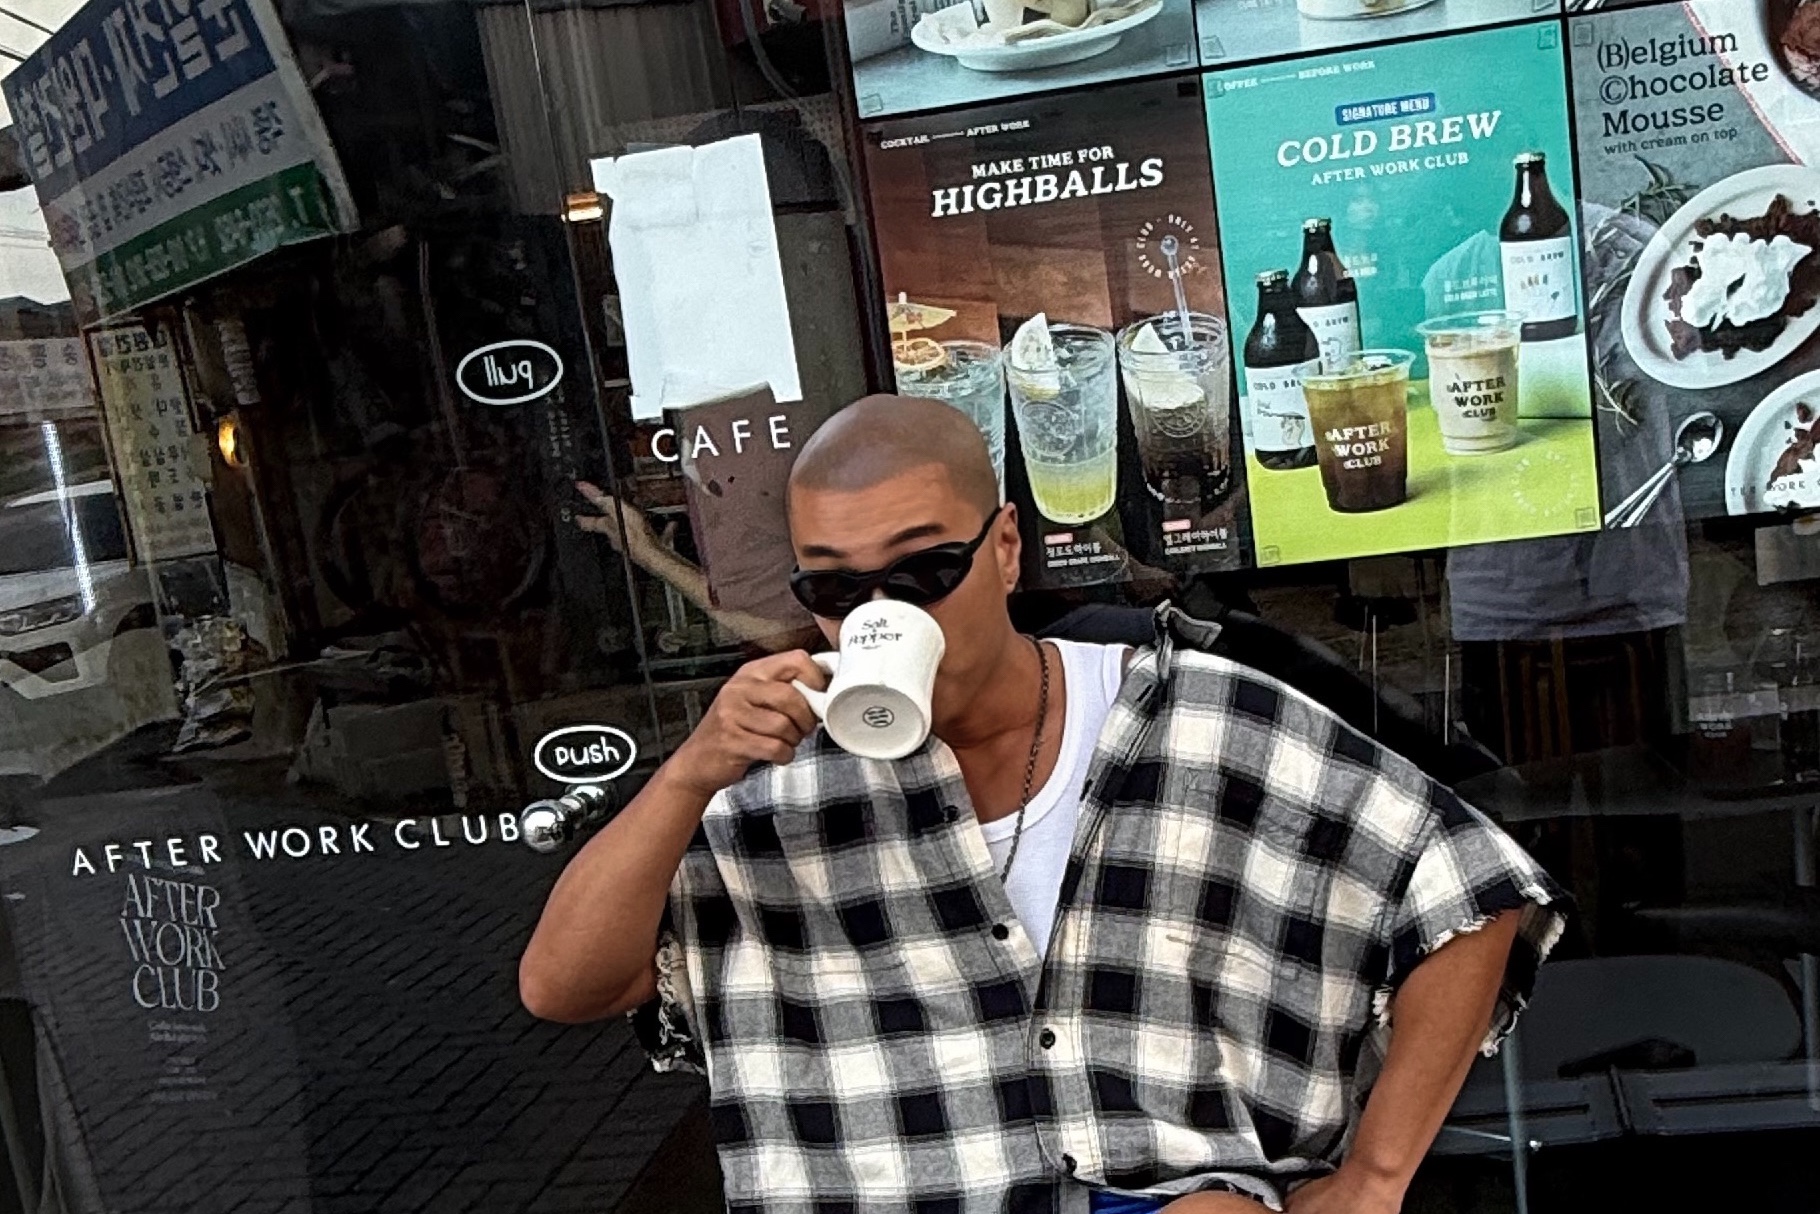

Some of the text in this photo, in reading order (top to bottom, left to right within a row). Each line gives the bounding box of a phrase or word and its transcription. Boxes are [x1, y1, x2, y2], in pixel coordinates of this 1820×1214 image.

[1343, 60, 1376, 72] WORK
[1597, 32, 1738, 73] (B)elgium
[1341, 97, 1430, 122] SIGNATURE MENU
[1602, 102, 1724, 138] Mousse
[881, 120, 1030, 149] COCKTAIL AFTER WORK
[1277, 110, 1502, 168] COLD BREW
[1604, 127, 1738, 155] with cream on top
[972, 146, 1115, 179] MAKE TIME FOR
[1310, 152, 1469, 186] AFTER WORK CLUB
[931, 158, 1164, 217] HIGHBALLS
[1447, 376, 1506, 393] AFTER
[1454, 391, 1504, 407] WORK
[1463, 407, 1496, 418] CLUB
[650, 415, 792, 462] CAFE
[1325, 421, 1391, 441] AFTER
[1333, 437, 1390, 457] WORK
[1344, 455, 1382, 469] CLUB
[72, 812, 520, 876] AFTER WORK CLUB
[120, 873, 221, 928] AFTER
[119, 918, 227, 971] WORK
[132, 963, 220, 1013] CLUB
